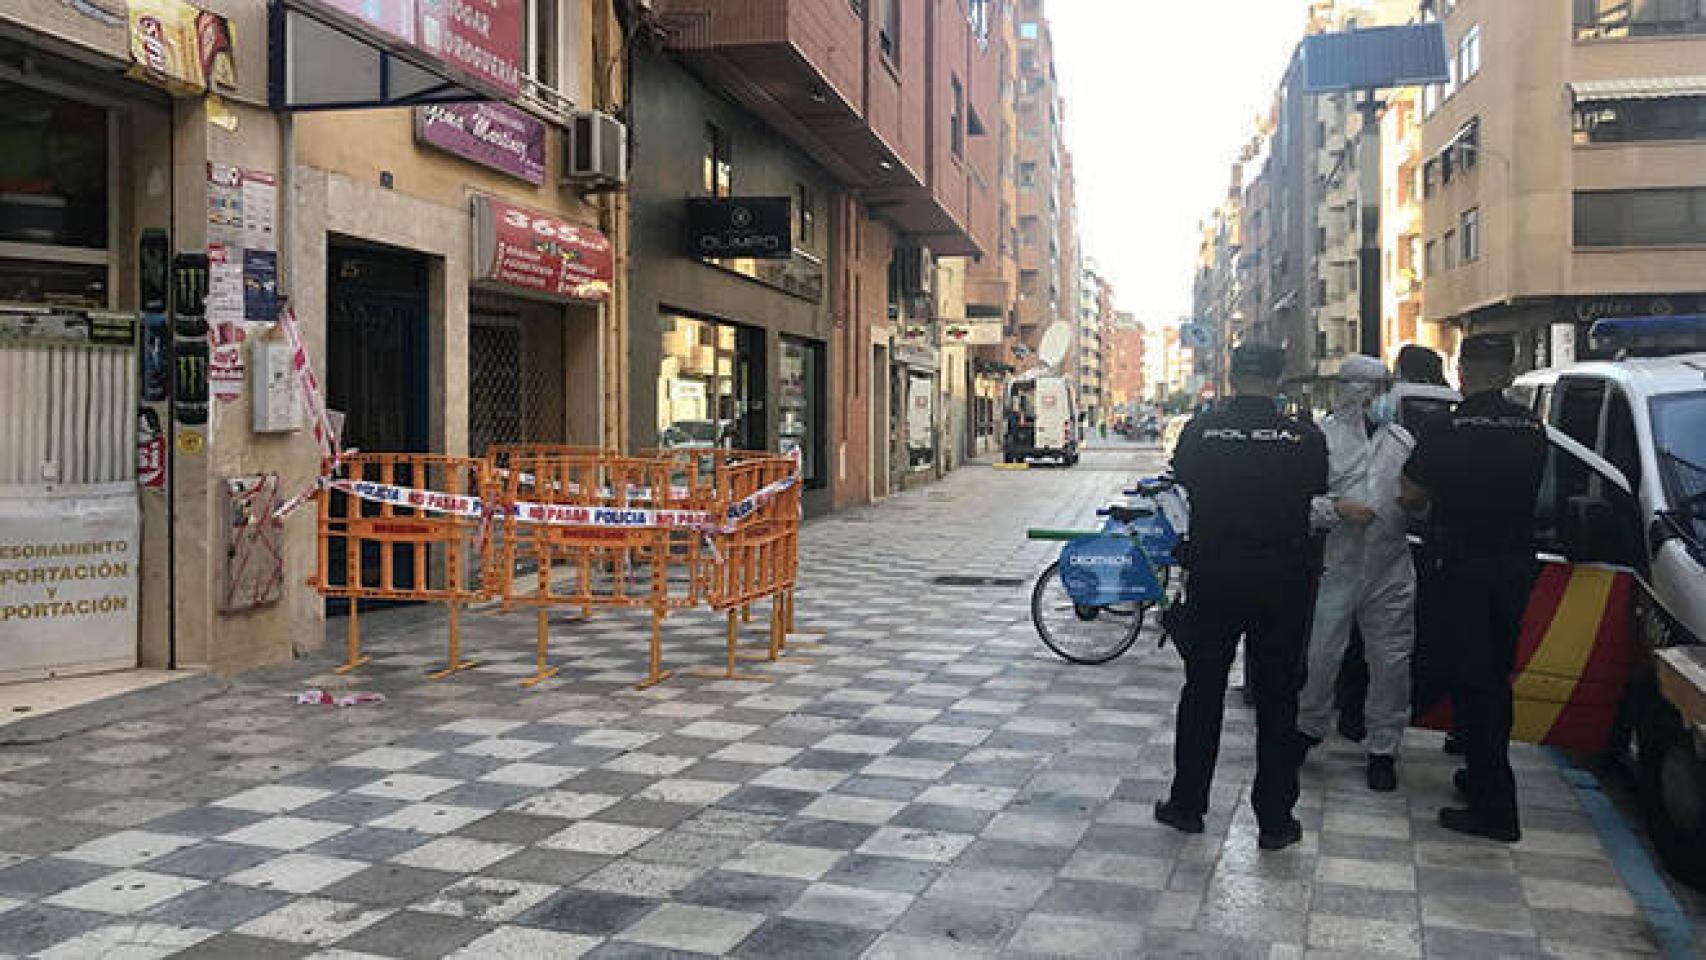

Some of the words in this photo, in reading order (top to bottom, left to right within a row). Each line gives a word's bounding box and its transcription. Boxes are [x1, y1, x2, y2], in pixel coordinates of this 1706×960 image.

[1453, 415, 1538, 428] POLICIA
[1202, 429, 1299, 441] POLICIA
[355, 483, 399, 501] POLICIA
[408, 491, 425, 505] NO
[428, 494, 469, 511] PASAR
[529, 506, 545, 520] NO
[548, 507, 589, 523] PASAR
[594, 510, 646, 524] POLICIA
[656, 512, 674, 524] NO
[0, 560, 128, 585] PORTACIÓN
[46, 587, 58, 600] Y
